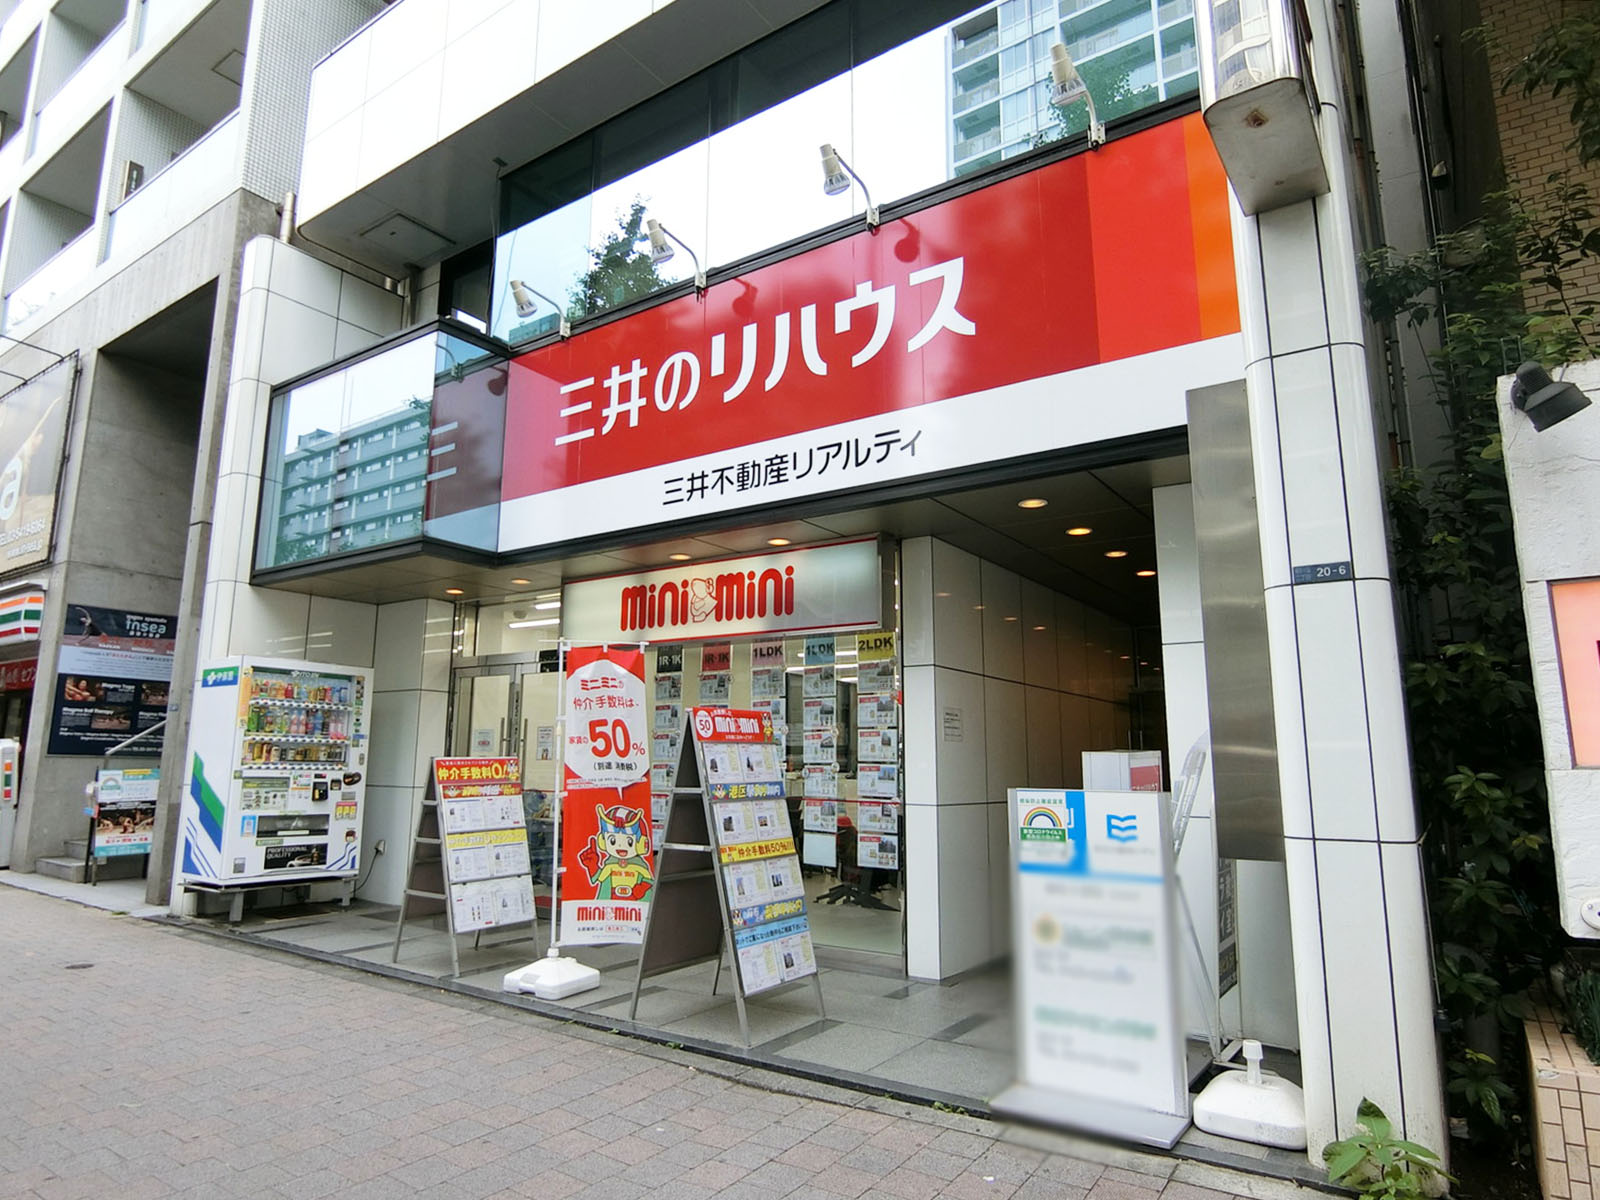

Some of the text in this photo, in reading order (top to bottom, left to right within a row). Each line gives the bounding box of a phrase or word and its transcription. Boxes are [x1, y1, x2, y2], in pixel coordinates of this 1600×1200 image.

[555, 257, 976, 446] 三井のリハウス
[662, 430, 922, 506] 三井不動産リアルティ
[1316, 565, 1347, 577] 20-6
[620, 566, 794, 631] mini mini
[806, 643, 834, 655] 1LDK
[858, 637, 894, 651] 2LDK
[753, 646, 783, 658] 1LDK
[699, 719, 711, 731] 50
[266, 852, 291, 860] QUALITY
[577, 906, 641, 921] mini mini
